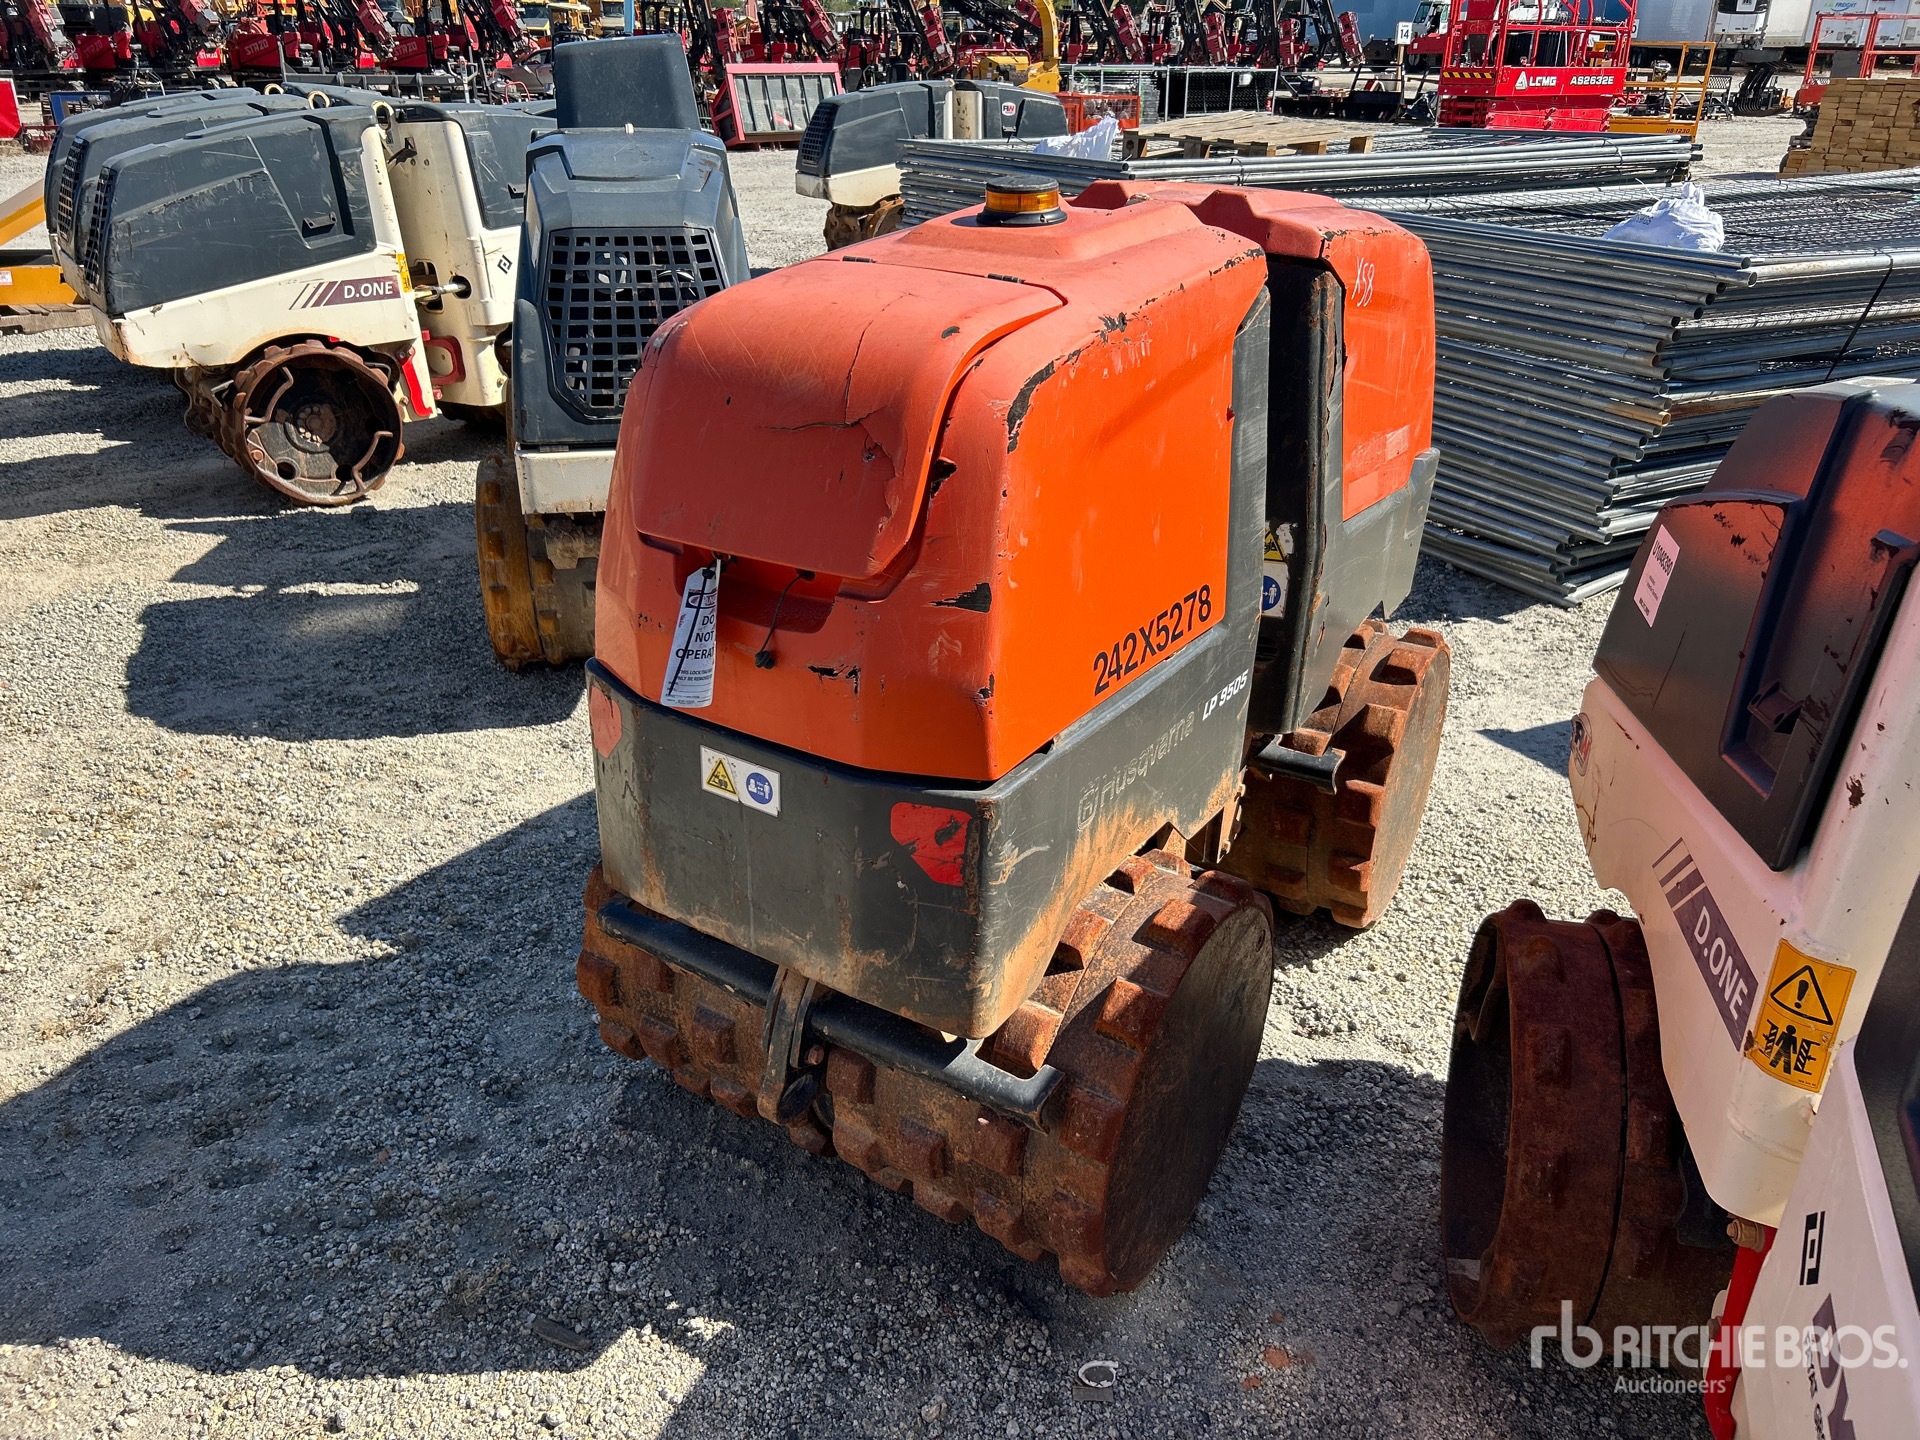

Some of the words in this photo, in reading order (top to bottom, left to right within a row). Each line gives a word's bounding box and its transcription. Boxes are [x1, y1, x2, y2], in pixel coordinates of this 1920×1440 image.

[1400, 29, 1409, 39] 14
[1569, 75, 1615, 86] AS2632E
[344, 281, 393, 299] D.ONE
[702, 614, 714, 626] DO
[695, 630, 714, 643] NOT
[1093, 584, 1212, 697] 242X5278
[1202, 694, 1218, 721] LP
[1219, 669, 1249, 707] 9505
[1694, 906, 1748, 1020] D.ONE
